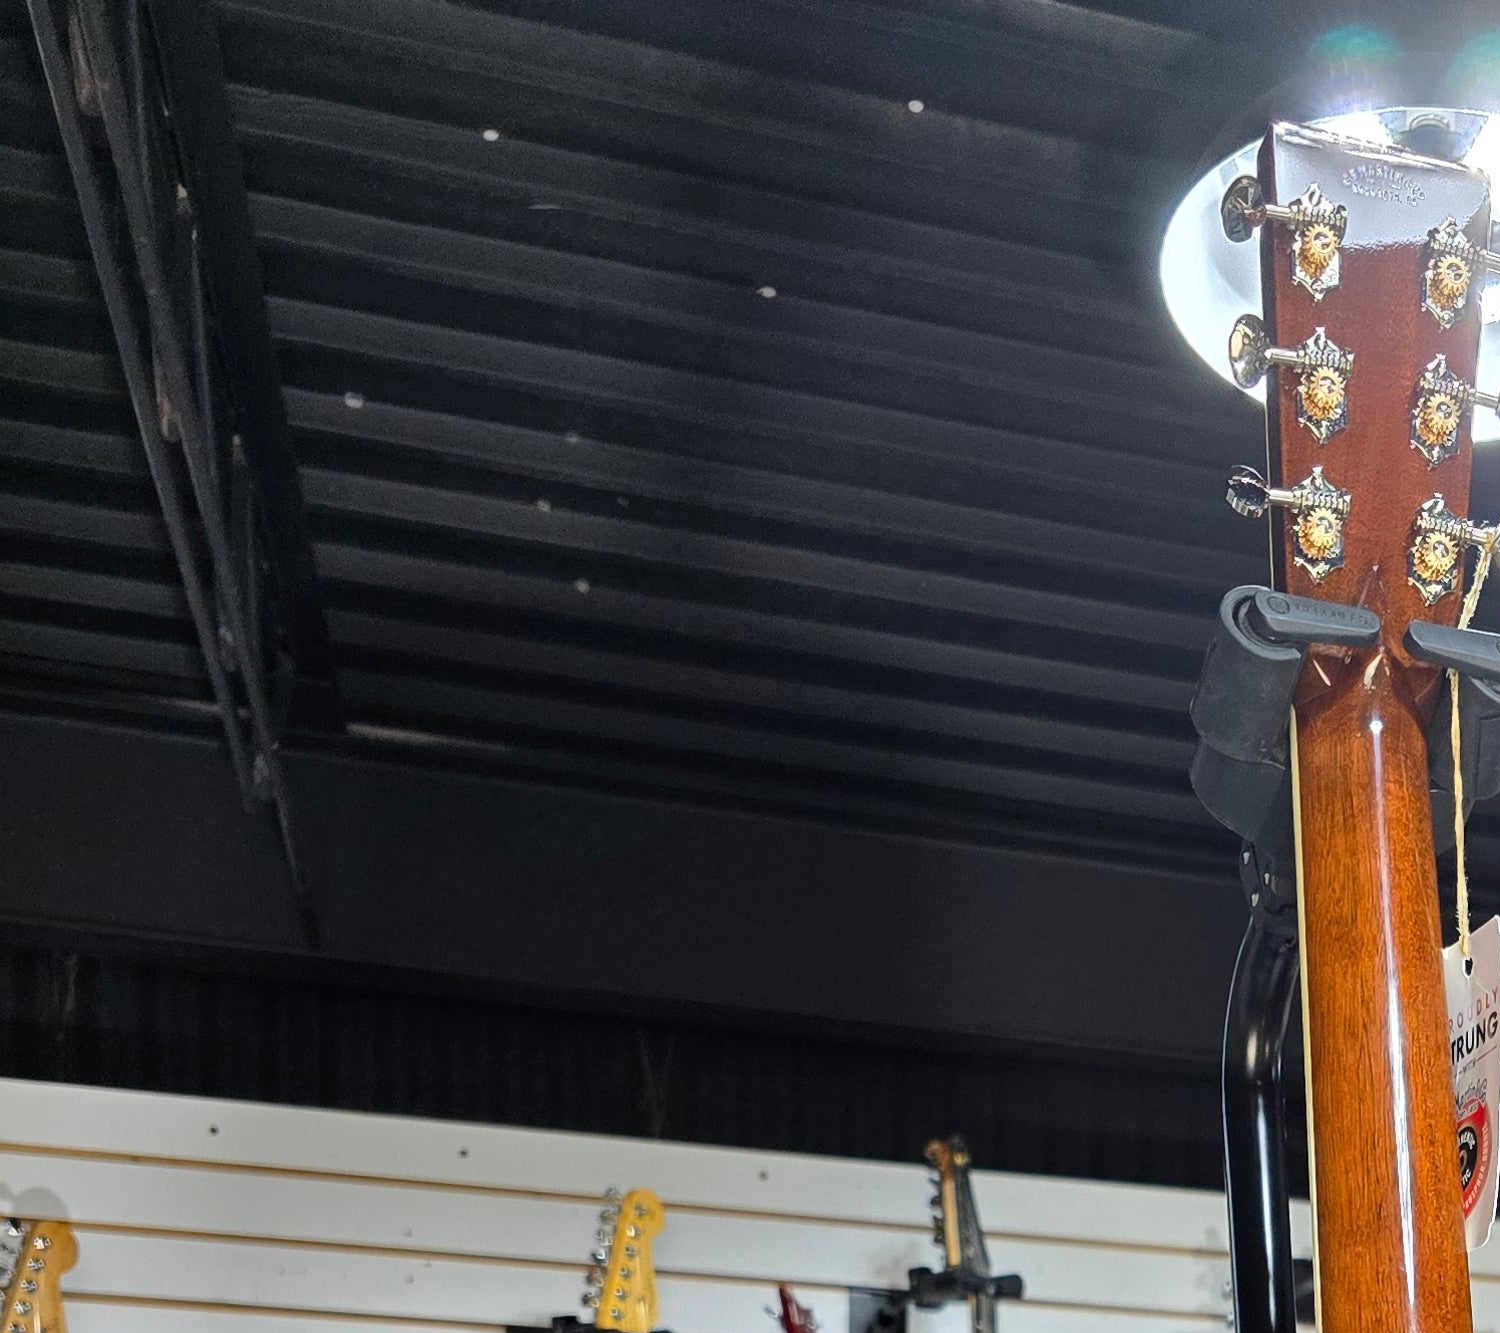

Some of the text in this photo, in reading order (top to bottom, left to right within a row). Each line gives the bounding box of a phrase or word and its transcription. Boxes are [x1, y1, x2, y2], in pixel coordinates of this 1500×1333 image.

[1449, 986, 1498, 1036] ROUDLY
[1451, 1011, 1499, 1067] TRUNG
[1464, 1164, 1486, 1211] HOSPHOR
